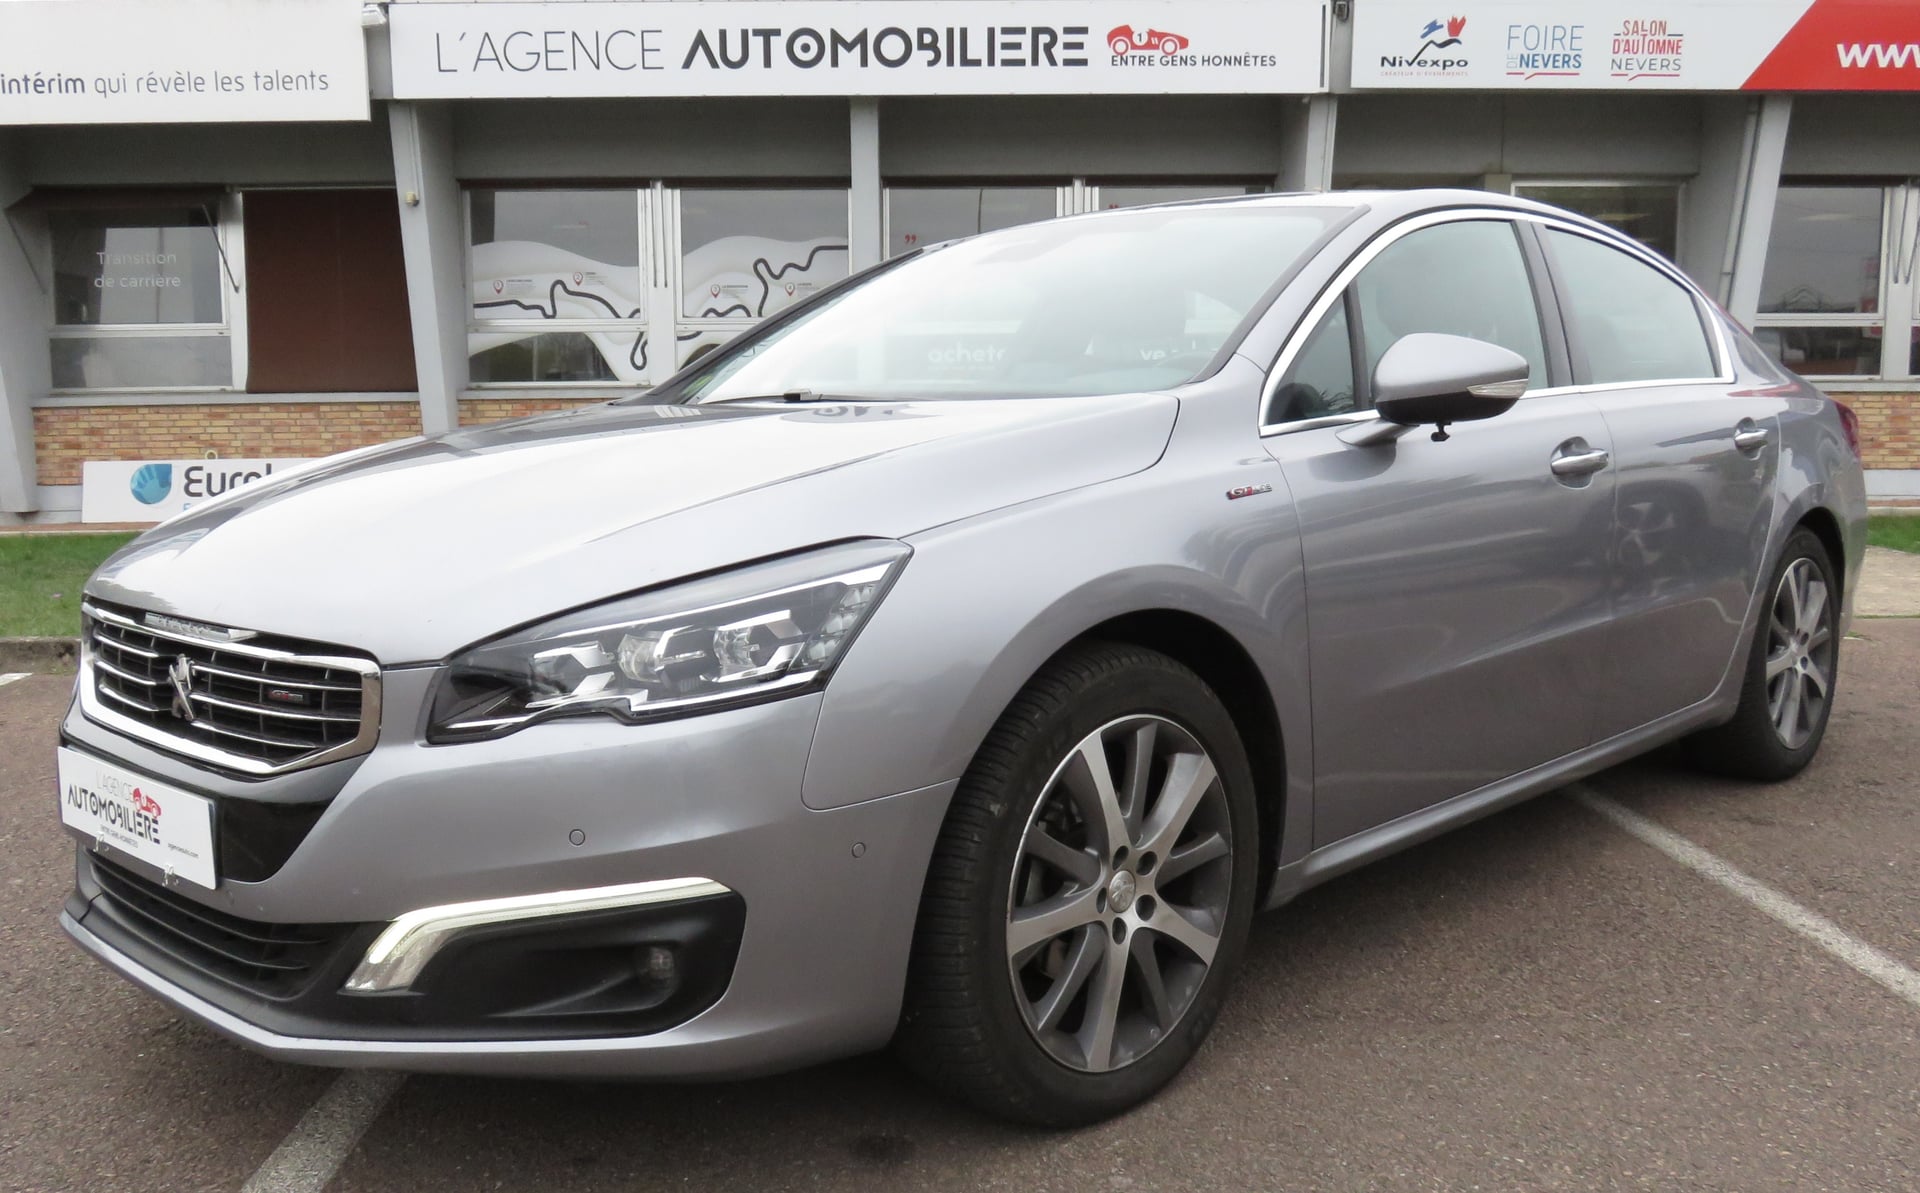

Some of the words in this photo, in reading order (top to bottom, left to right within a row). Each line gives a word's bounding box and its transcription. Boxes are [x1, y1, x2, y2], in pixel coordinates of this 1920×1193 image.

[1622, 20, 1667, 36] SALON
[1507, 25, 1584, 51] FOIRE
[1612, 34, 1683, 55] D'AUTOMNE
[435, 29, 664, 73] L'AGENCE
[681, 26, 1089, 69] AUTOMOBILIERE
[1836, 43, 1920, 69] ww
[1111, 54, 1155, 67] ENTRE
[1159, 54, 1197, 67] GENS
[1201, 52, 1277, 67] HONNÊTES
[1380, 56, 1469, 70] Nivexpo
[1519, 53, 1582, 69] NEVERS
[1611, 58, 1682, 71] NEVERS
[0, 72, 86, 94] intérim
[94, 73, 127, 99] qui
[136, 71, 206, 94] révèle
[214, 70, 245, 92] les
[254, 69, 329, 92] talents
[96, 250, 177, 265] Transition
[94, 274, 115, 288] de
[68, 784, 161, 845] AUTOMOBILIERE
